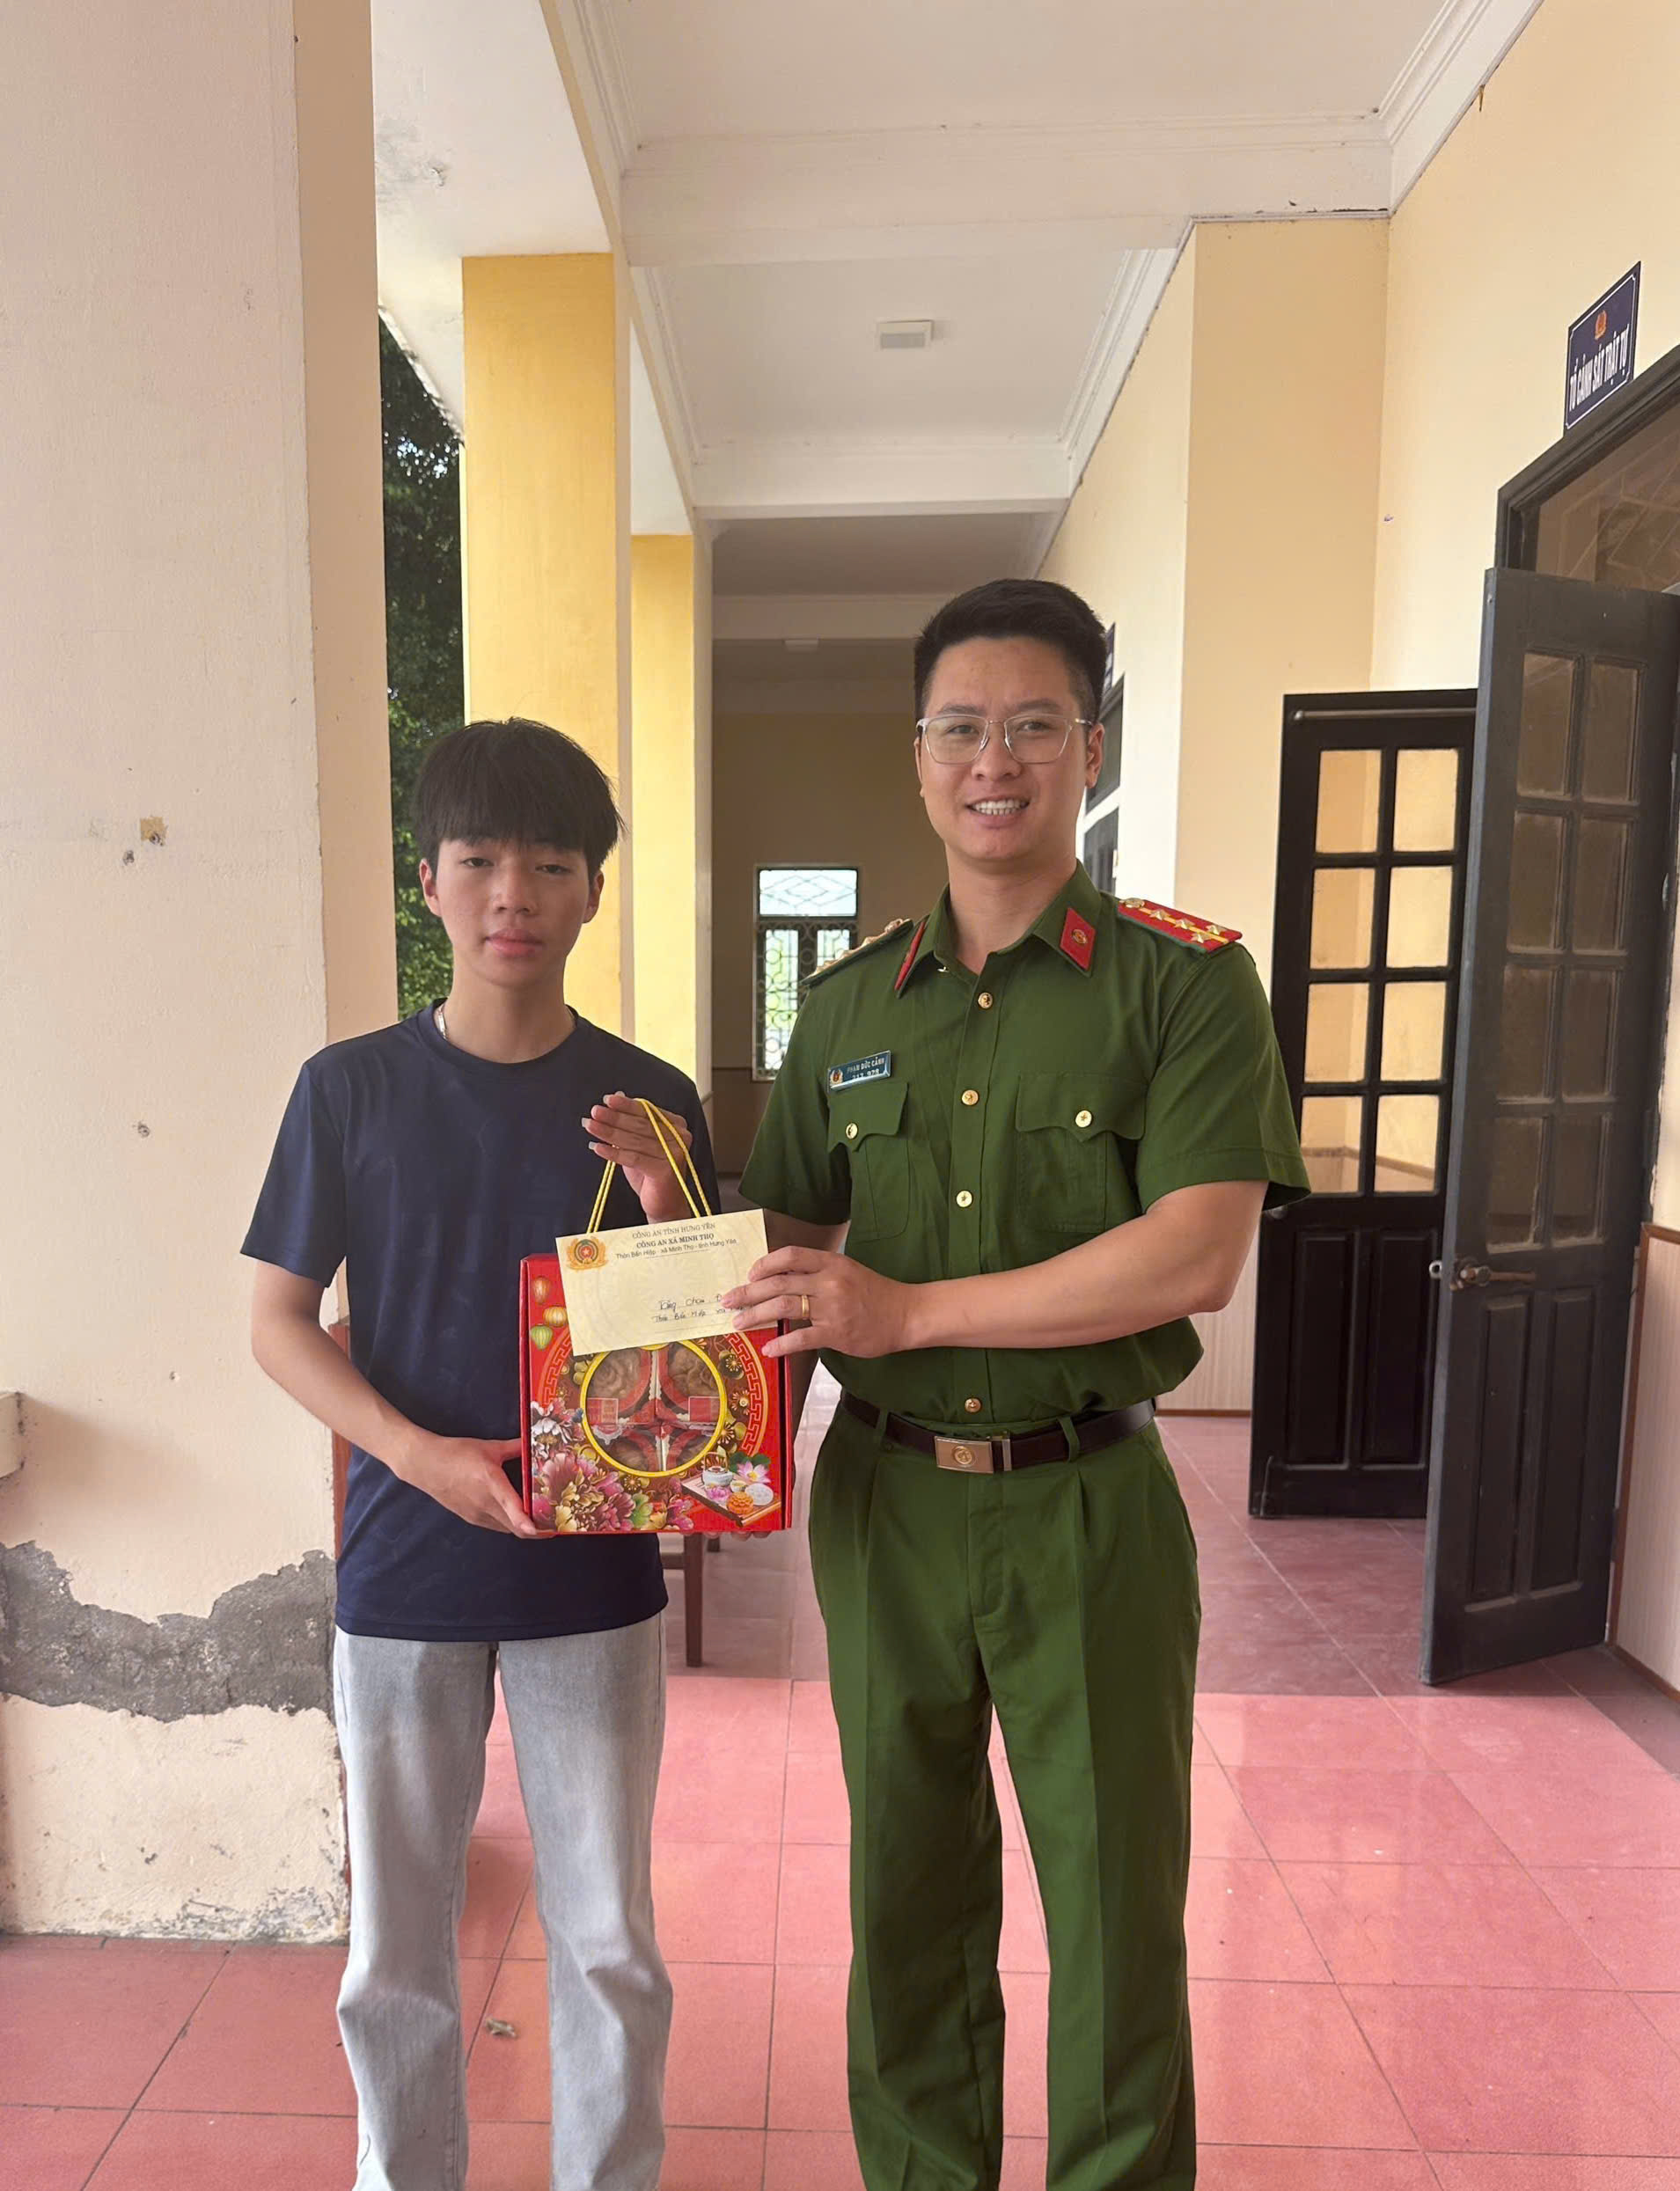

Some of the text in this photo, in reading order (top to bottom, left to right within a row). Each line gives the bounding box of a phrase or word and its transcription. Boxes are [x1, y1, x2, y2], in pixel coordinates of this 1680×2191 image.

[1577, 354, 1594, 406] CẢNH
[1592, 343, 1605, 393] SÁT
[1603, 331, 1620, 385] TRẬT
[1619, 323, 1630, 377] TỰ
[632, 1230, 651, 1239] CÔNG
[680, 1224, 701, 1233] HƯNG
[701, 1221, 715, 1230] YÊN
[636, 1239, 657, 1249] CÔNG
[679, 1235, 699, 1243] MINH
